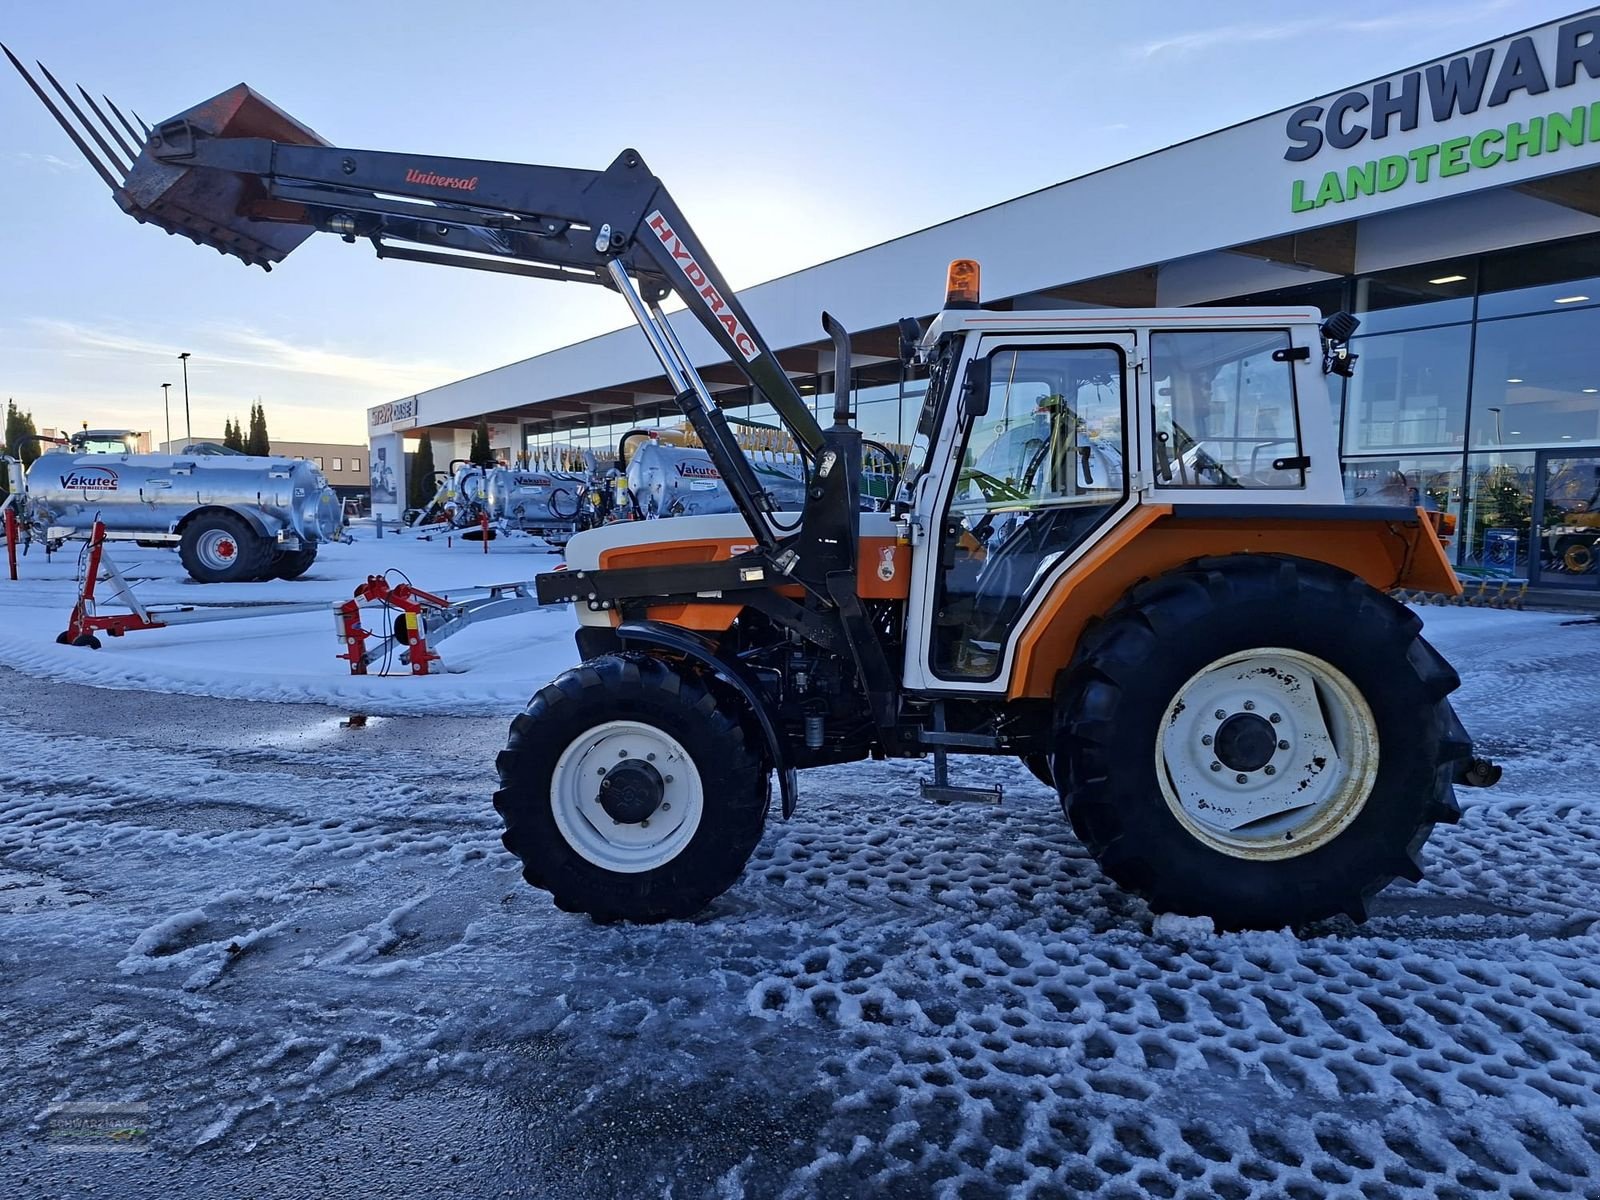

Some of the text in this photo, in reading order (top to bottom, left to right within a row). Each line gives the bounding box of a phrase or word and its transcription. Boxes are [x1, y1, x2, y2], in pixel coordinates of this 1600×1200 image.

[1284, 15, 1600, 162] SCHWAR
[406, 168, 478, 190] Universal
[650, 215, 755, 356] HYDRAC
[60, 472, 118, 489] Vakutec
[675, 462, 718, 477] Vakute
